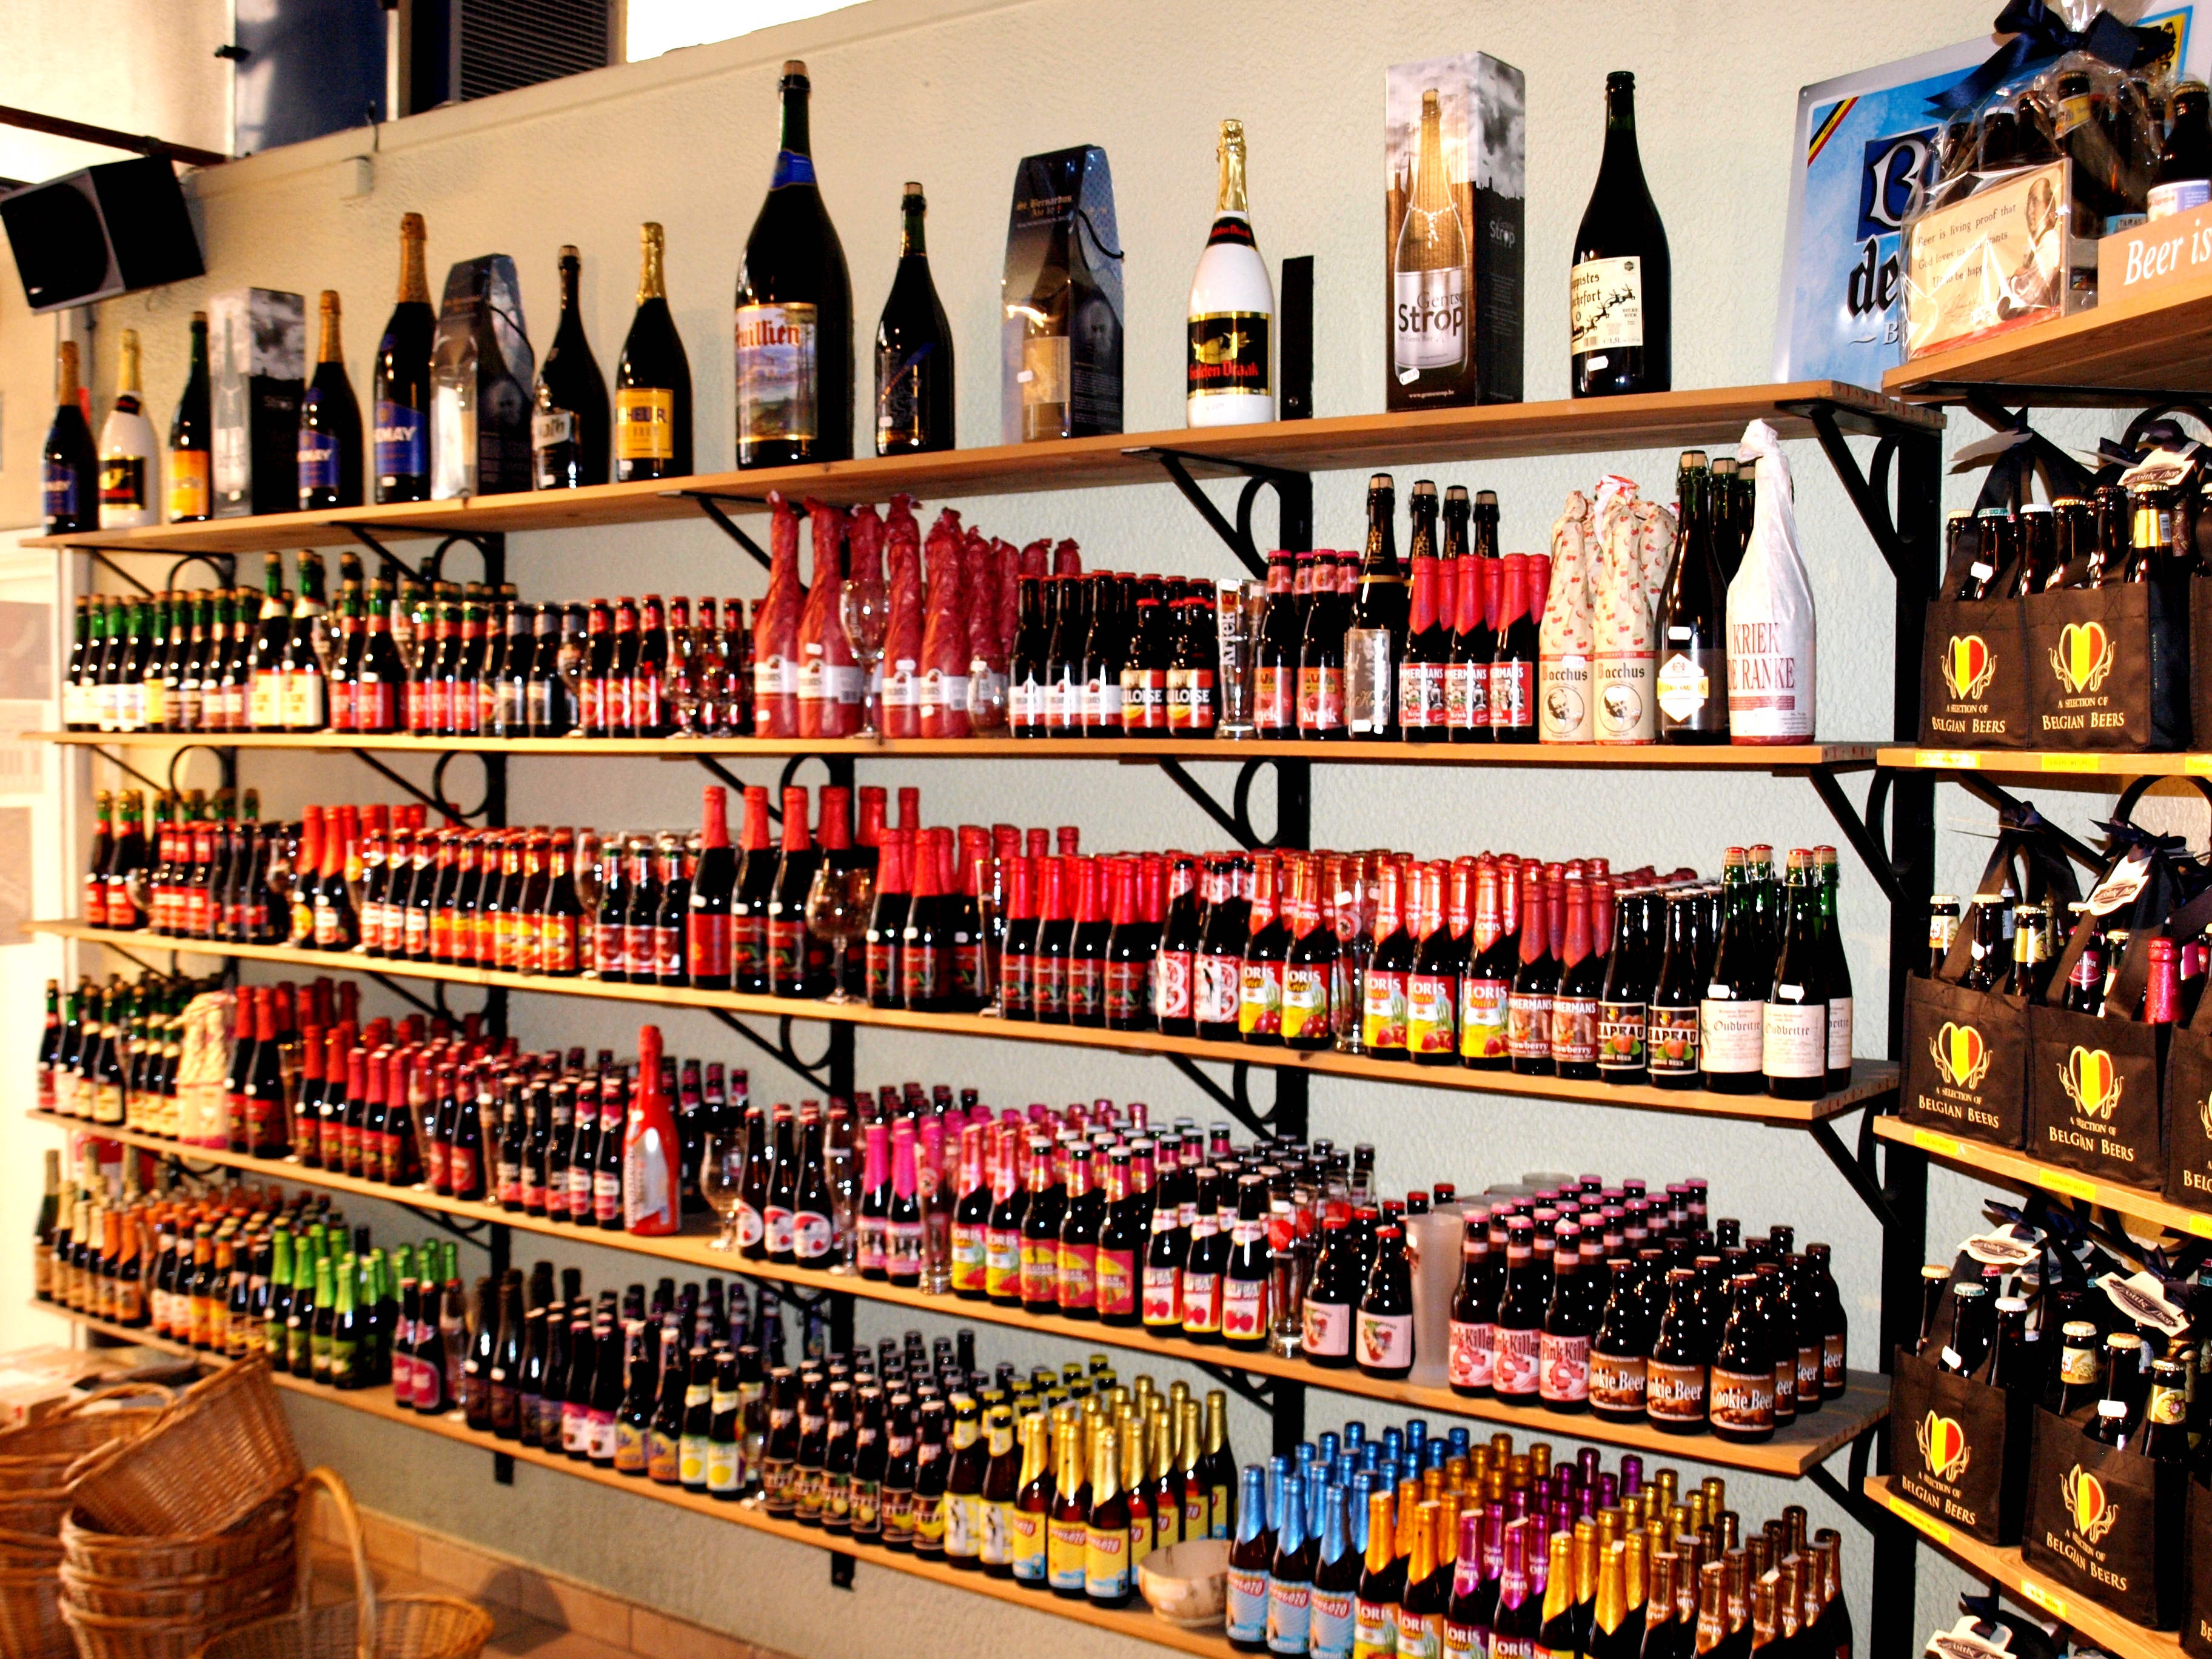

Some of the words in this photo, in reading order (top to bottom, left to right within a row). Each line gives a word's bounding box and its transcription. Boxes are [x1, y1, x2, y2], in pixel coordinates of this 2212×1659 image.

[1940, 229, 1946, 240] is
[1950, 221, 1971, 236] living
[1976, 209, 1997, 229] proof
[2001, 204, 2016, 216] that
[1919, 256, 1933, 270] God
[1936, 251, 1954, 264] loves
[2123, 237, 2184, 285] Beer
[1956, 271, 1964, 281] be
[1398, 303, 1464, 337] Strop
[1222, 360, 1259, 377] Draak
[1733, 623, 1780, 655] KRIEK
[1541, 665, 1588, 681] Bacchus
[1597, 662, 1646, 679] Bacchus
[1742, 657, 1796, 690] RANKE
[1946, 704, 1950, 712] A
[1979, 705, 1989, 714] OF
[2057, 699, 2063, 708] A
[2098, 696, 2108, 707] OF
[1932, 716, 1966, 734] BELGIAN
[1972, 718, 2006, 734] BEERS
[2042, 714, 2084, 731] BELGIAN
[2090, 712, 2125, 728] BEERS
[1919, 1094, 1962, 1119] BELGIAN
[1968, 1107, 1999, 1129] BEERS
[1973, 1096, 1983, 1105] OF
[2070, 1116, 2074, 1125] A
[2108, 1126, 2117, 1137] OF
[2049, 1126, 2094, 1152] BELGIAN
[2101, 1139, 2134, 1162] BEERS
[1619, 1369, 1646, 1392] Beer
[1675, 1379, 1703, 1401] Beer
[1777, 1379, 1794, 1395] eer
[1712, 1381, 1749, 1410] Cookie
[1751, 1387, 1774, 1411] Beer
[1918, 1470, 1922, 1480] A
[1952, 1487, 1962, 1499] OF
[1902, 1474, 1940, 1509] BELGIAN
[1945, 1498, 1976, 1526] BEERS
[2065, 1528, 2071, 1538] A
[2095, 1549, 2106, 1563] OF
[2046, 1530, 2086, 1572] BELGIAN
[2090, 1560, 2128, 1592] BEERS
